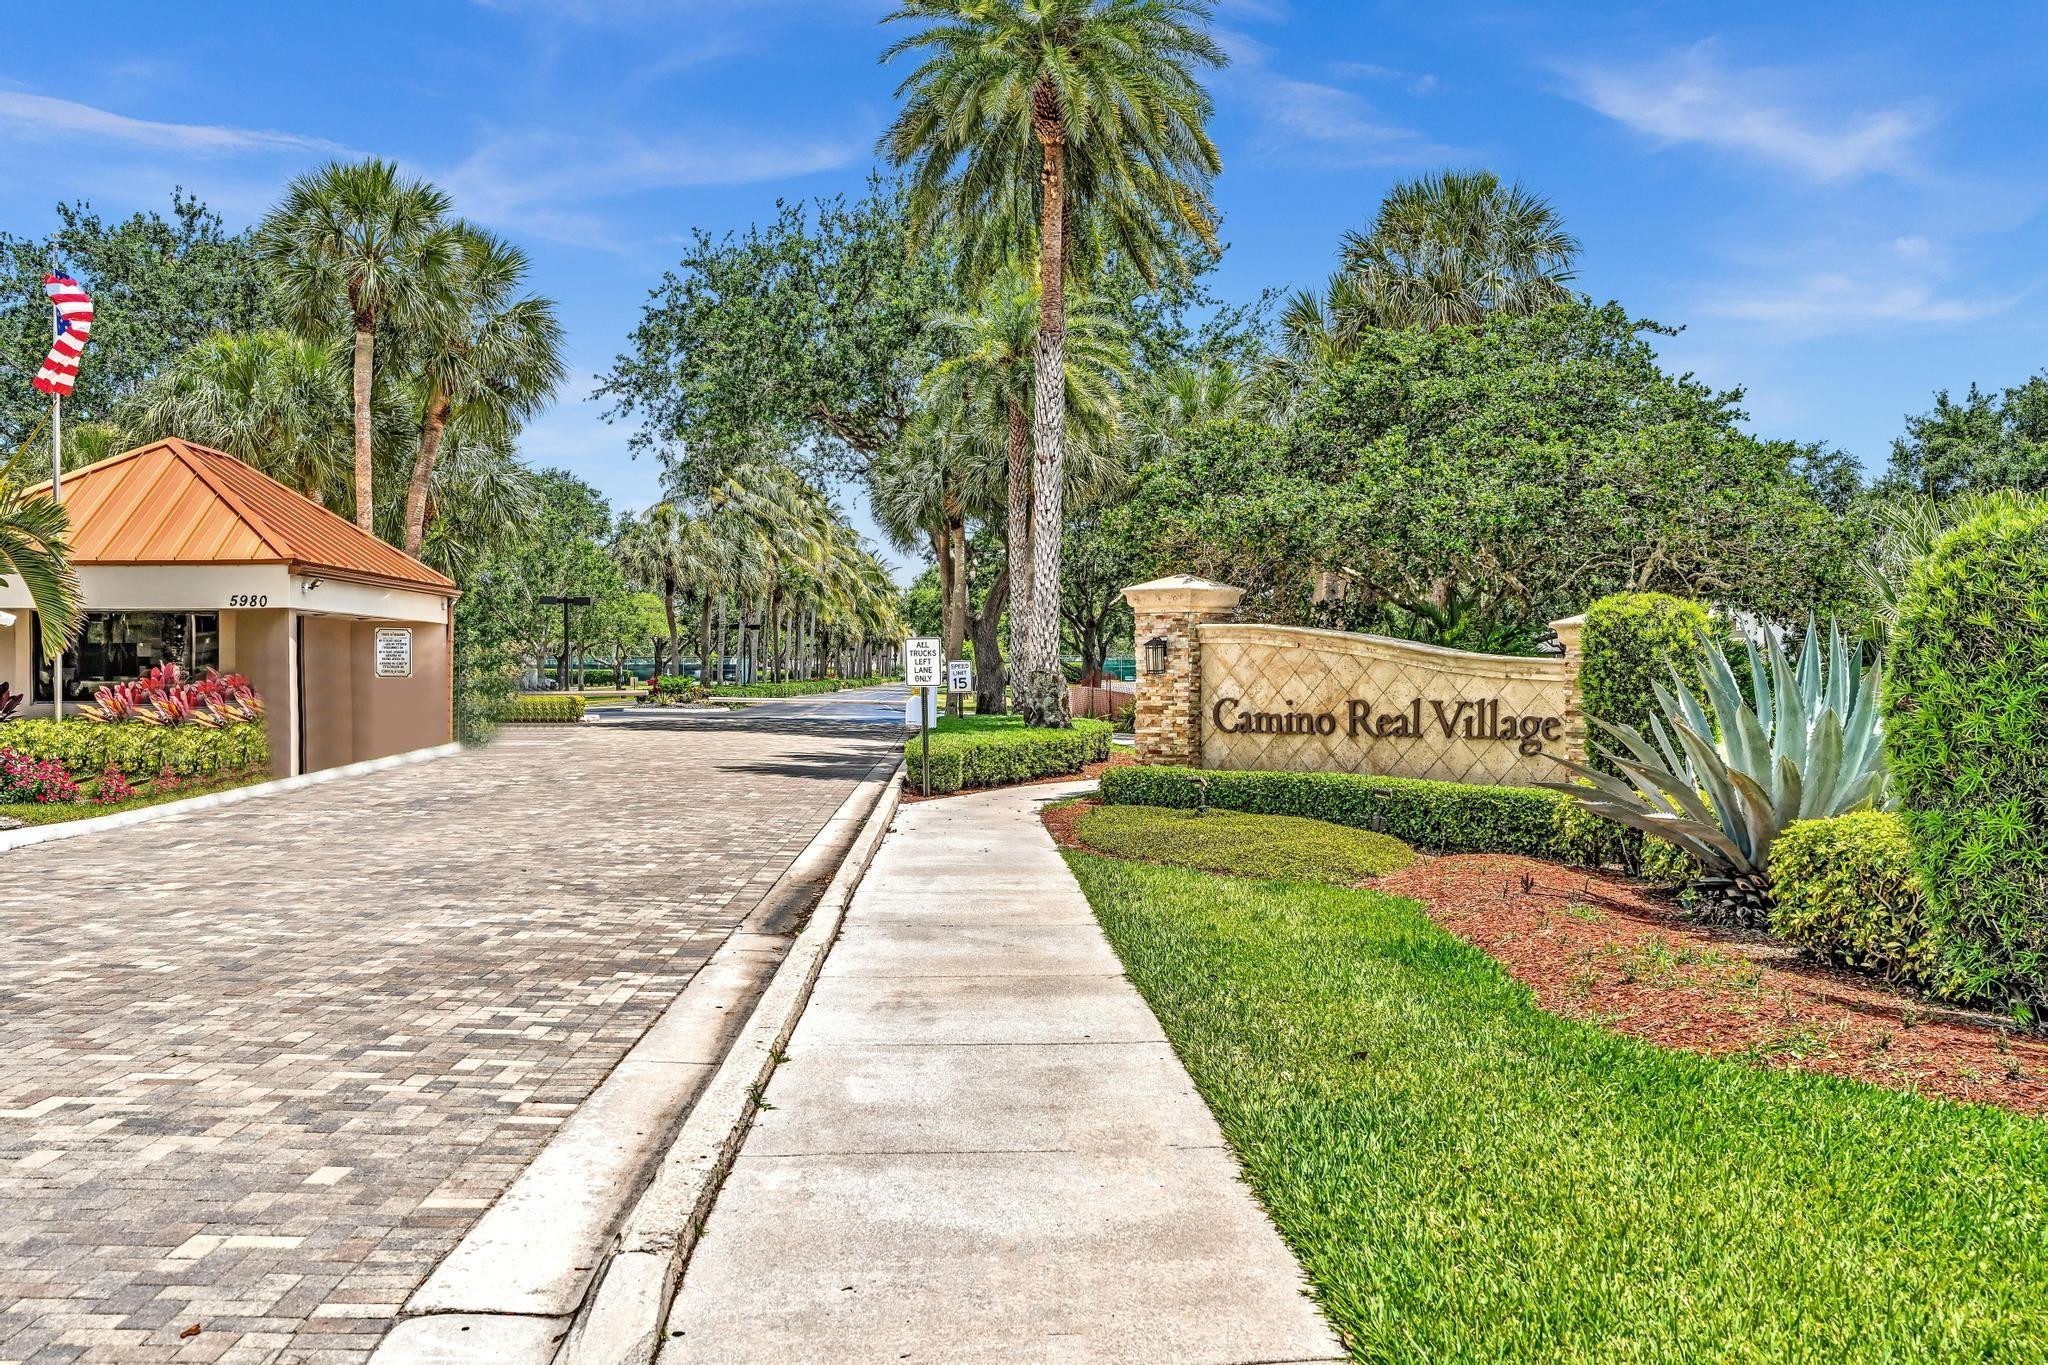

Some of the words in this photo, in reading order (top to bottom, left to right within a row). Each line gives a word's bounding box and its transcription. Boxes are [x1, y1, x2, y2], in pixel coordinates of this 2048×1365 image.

[229, 594, 268, 607] 5980
[916, 641, 929, 649] ALL
[909, 649, 937, 657] TRUCKS
[914, 658, 931, 666] LEFT
[914, 666, 933, 674] LANE
[914, 675, 932, 683] ONLY
[953, 677, 968, 689] 15
[1212, 697, 1336, 736] Camino
[1346, 697, 1424, 739] Real
[1429, 698, 1562, 756] Village
